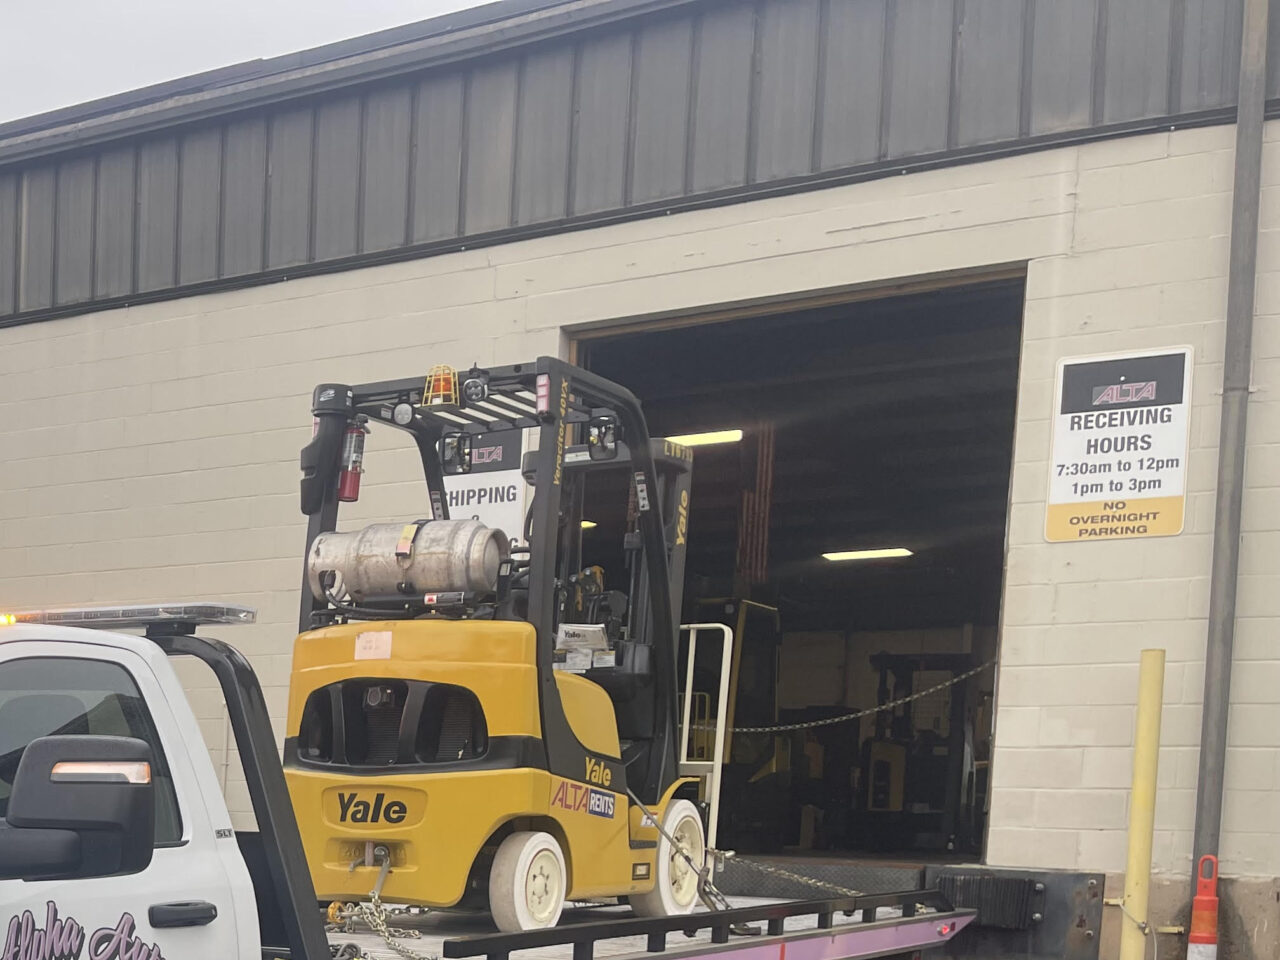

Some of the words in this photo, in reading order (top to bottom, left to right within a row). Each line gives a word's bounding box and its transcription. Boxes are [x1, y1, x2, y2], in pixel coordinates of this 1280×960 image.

[1093, 381, 1157, 406] ALTA
[1070, 408, 1172, 431] RECEIVING
[472, 445, 503, 465] LTA
[553, 420, 565, 485] Veracitor
[1086, 434, 1152, 455] HOURS
[1056, 463, 1112, 477] 7:30am
[1117, 459, 1132, 473] to
[1137, 457, 1180, 474] 12pm
[449, 485, 517, 507] HIPPING
[1072, 481, 1103, 497] 1pm
[1109, 479, 1123, 492] to
[1128, 478, 1162, 493] 3pm
[1103, 501, 1126, 511] NO
[676, 489, 688, 545] Yale
[1069, 511, 1160, 526] OVERNIGHT
[1078, 525, 1148, 538] PARKING
[564, 630, 581, 639] Yale
[585, 756, 612, 787] Yale
[338, 792, 407, 824] Yale
[551, 781, 589, 814] ALTA
[589, 792, 614, 816] RENTS
